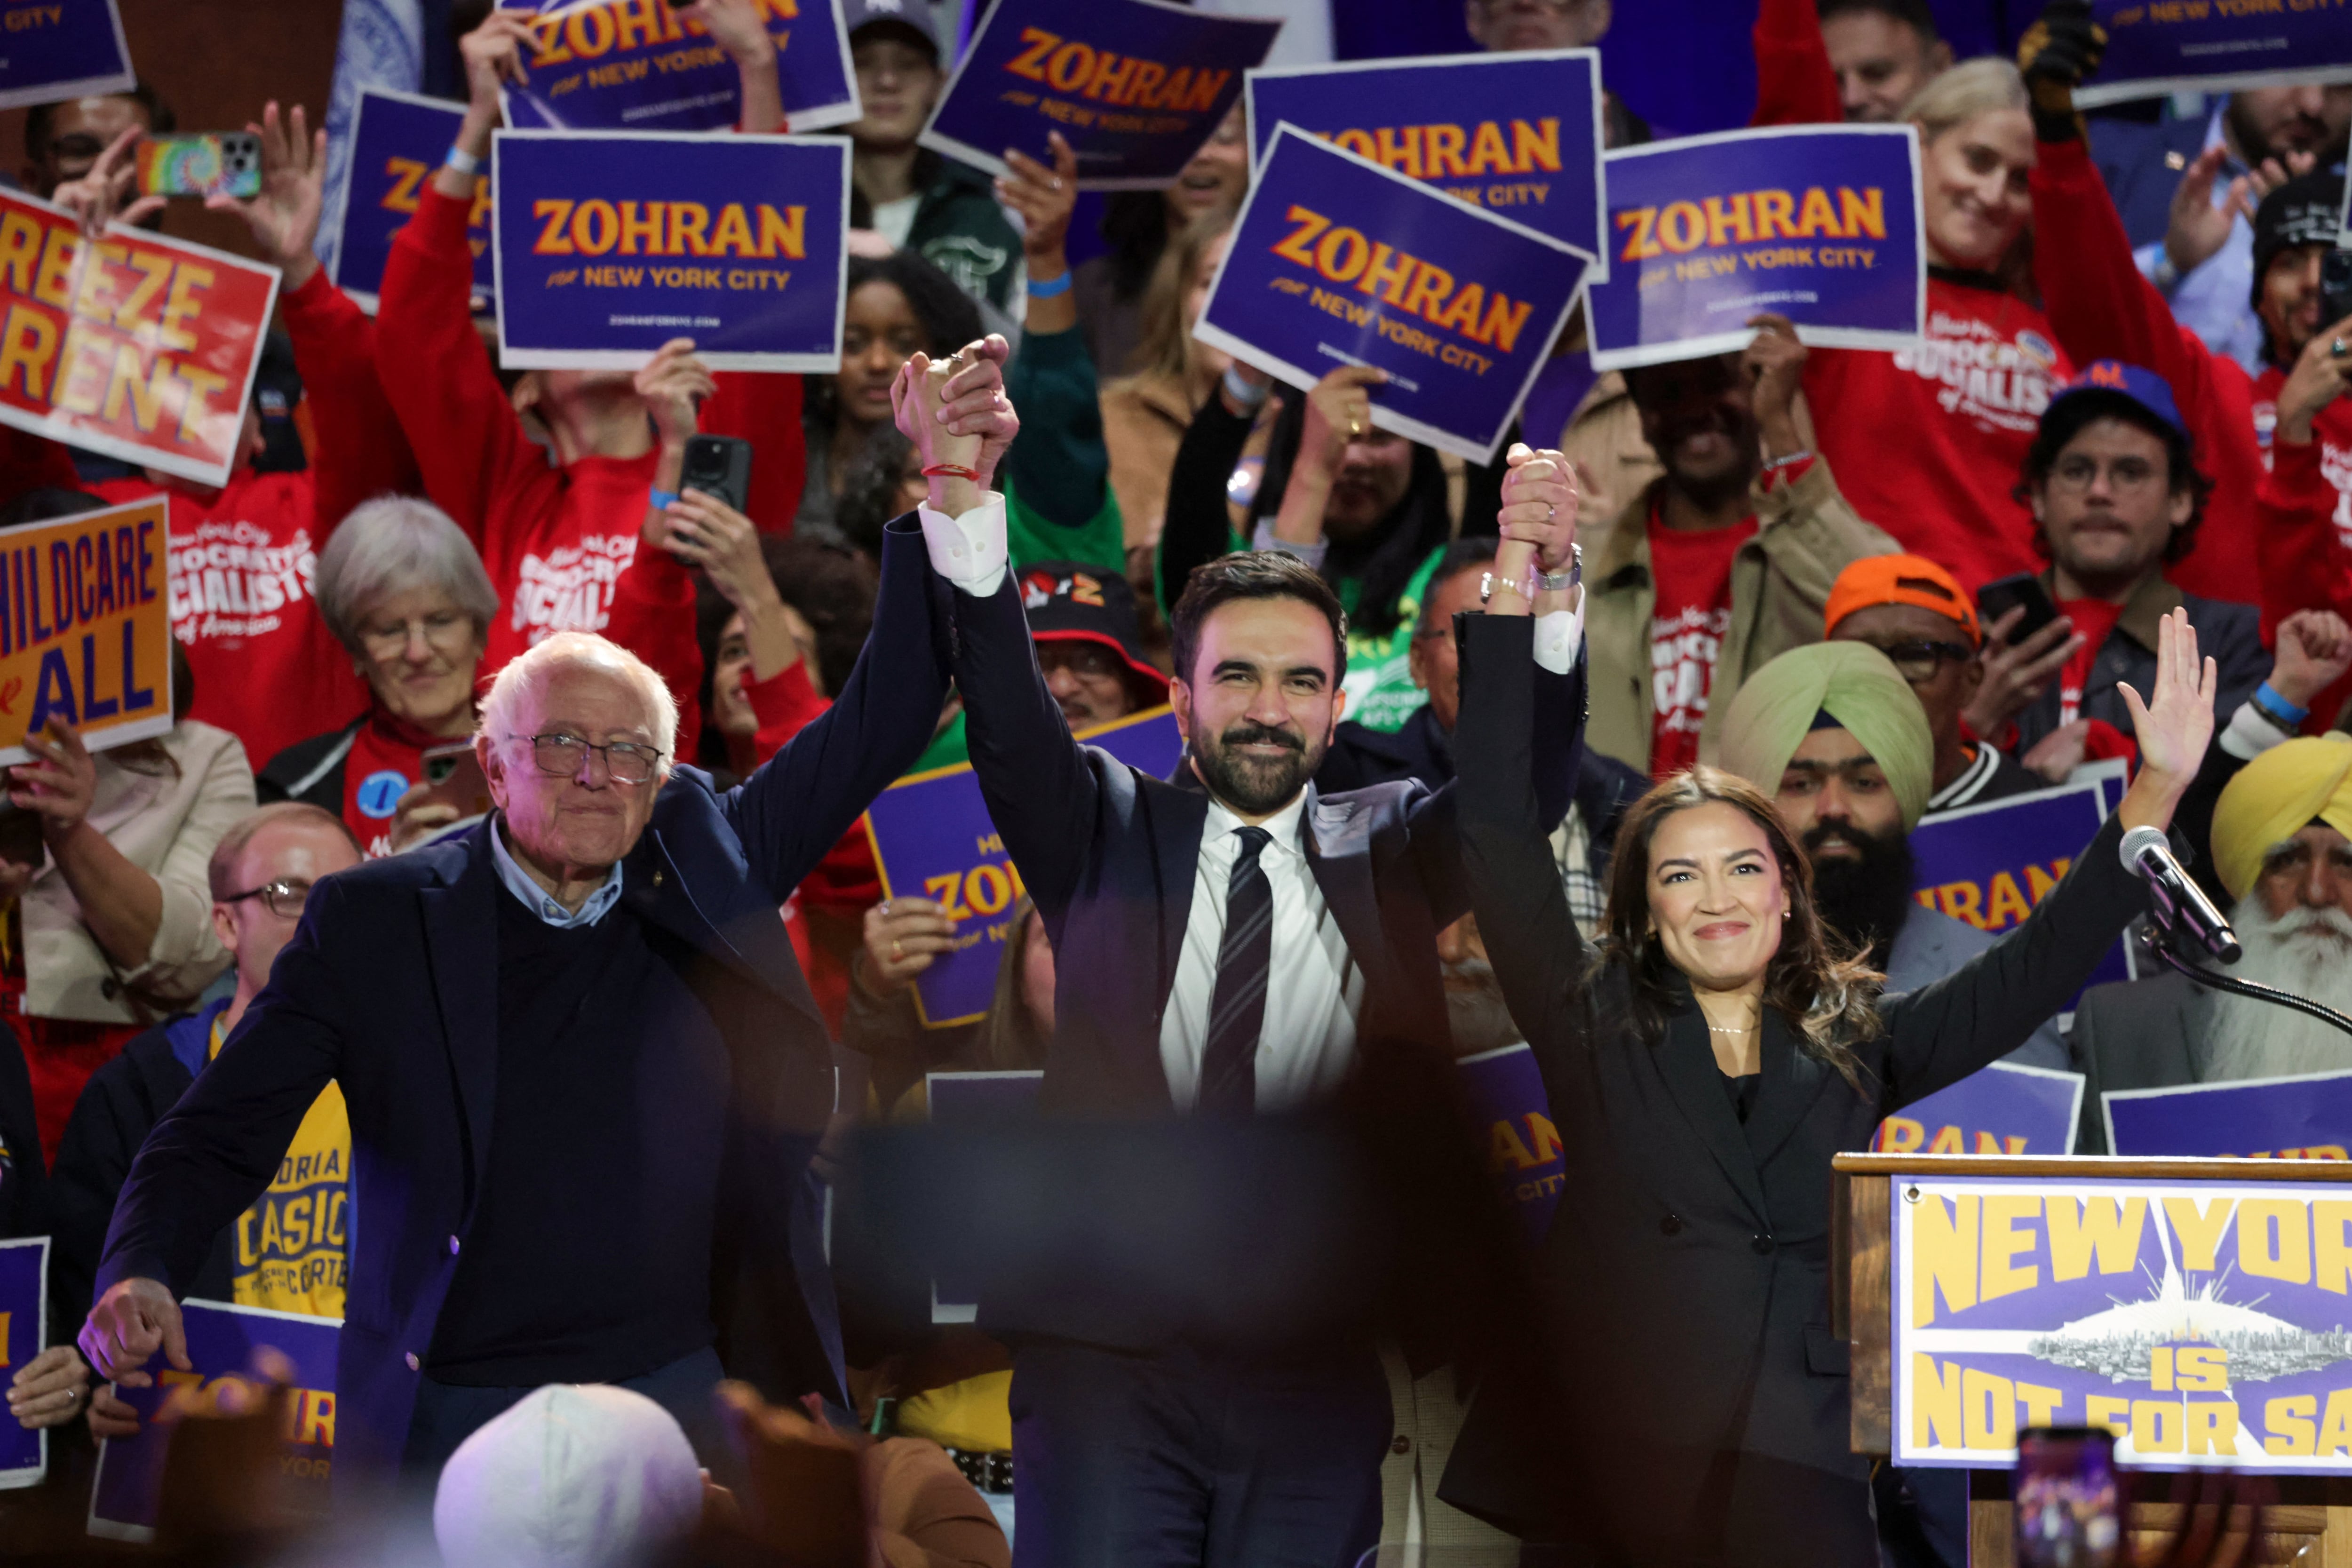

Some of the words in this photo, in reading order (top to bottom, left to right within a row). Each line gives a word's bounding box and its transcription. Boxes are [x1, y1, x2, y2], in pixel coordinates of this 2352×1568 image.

[531, 0, 799, 68] ZOH
[587, 58, 649, 89] NEW
[1002, 25, 1232, 112] ZOHRAN
[1311, 116, 1563, 180] OHRAN
[1486, 183, 1550, 207] CITY
[1615, 186, 1886, 263] ZOHRAN
[532, 199, 807, 260] ZOHRAN
[584, 266, 644, 287] NEW
[649, 266, 722, 289] YORK
[727, 269, 791, 291] CITY
[1269, 204, 1534, 353] ZOHRAN
[1675, 254, 1738, 282] NEW
[1742, 247, 1816, 271] YORK
[1818, 247, 1876, 270] CITY
[1309, 286, 1375, 327] NEW
[1376, 314, 1440, 358] YORK
[1440, 343, 1494, 376] CITY
[28, 619, 154, 734] ALL
[1913, 857, 2071, 931] RAN
[277, 1148, 339, 1184] ORIA
[1516, 1173, 1565, 1201] CIT
[1912, 1194, 2150, 1330] NEW
[2151, 1346, 2228, 1392] IS
[1912, 1351, 2063, 1451] NOT
[2086, 1394, 2239, 1456] FOR
